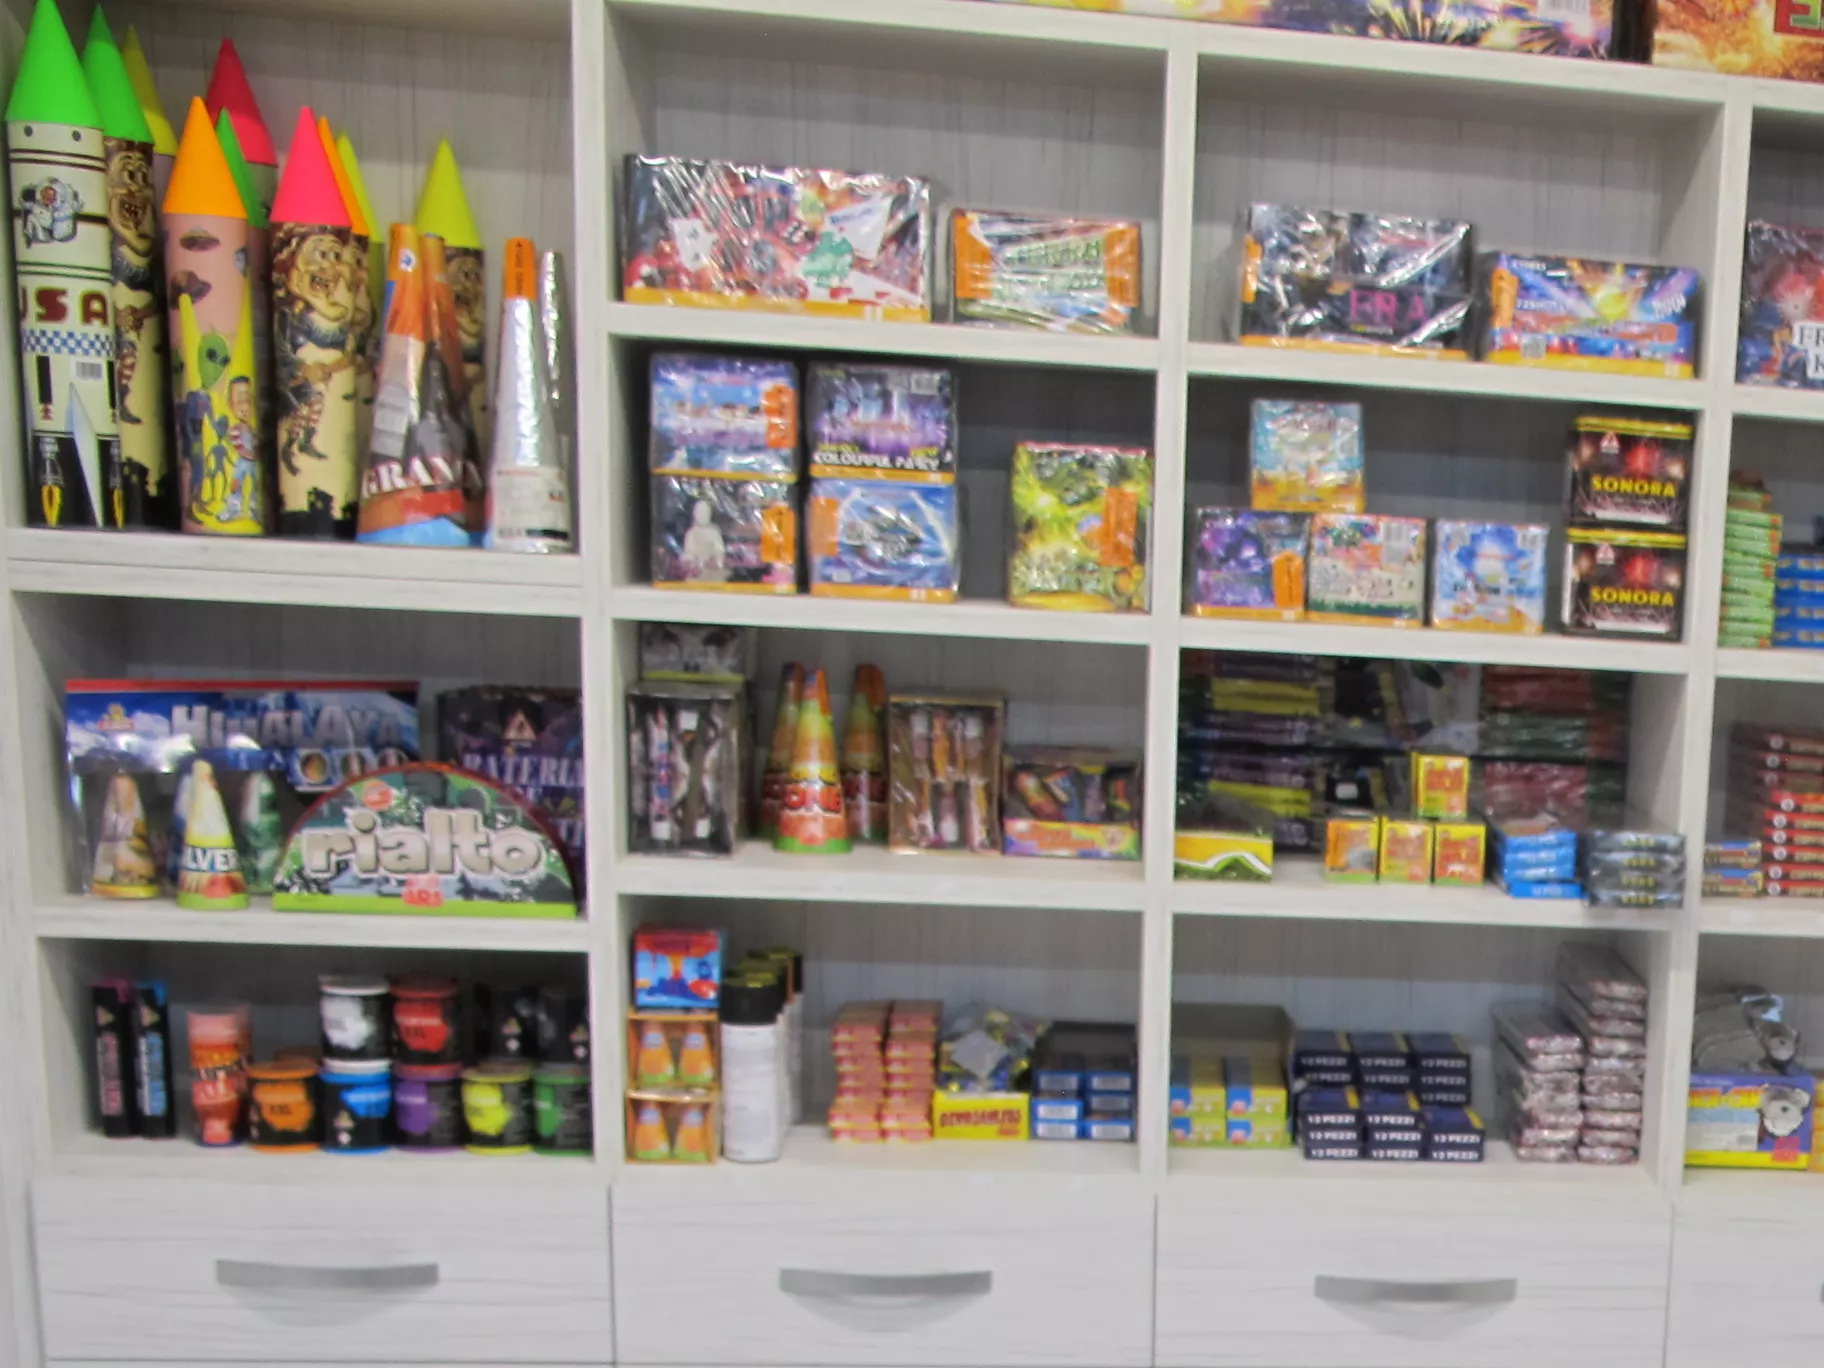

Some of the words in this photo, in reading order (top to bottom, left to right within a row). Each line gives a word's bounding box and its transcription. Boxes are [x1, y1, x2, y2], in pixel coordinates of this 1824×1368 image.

[1590, 475, 1677, 498] SONORA
[1590, 586, 1675, 607] SONORA
[304, 812, 542, 875] rialto
